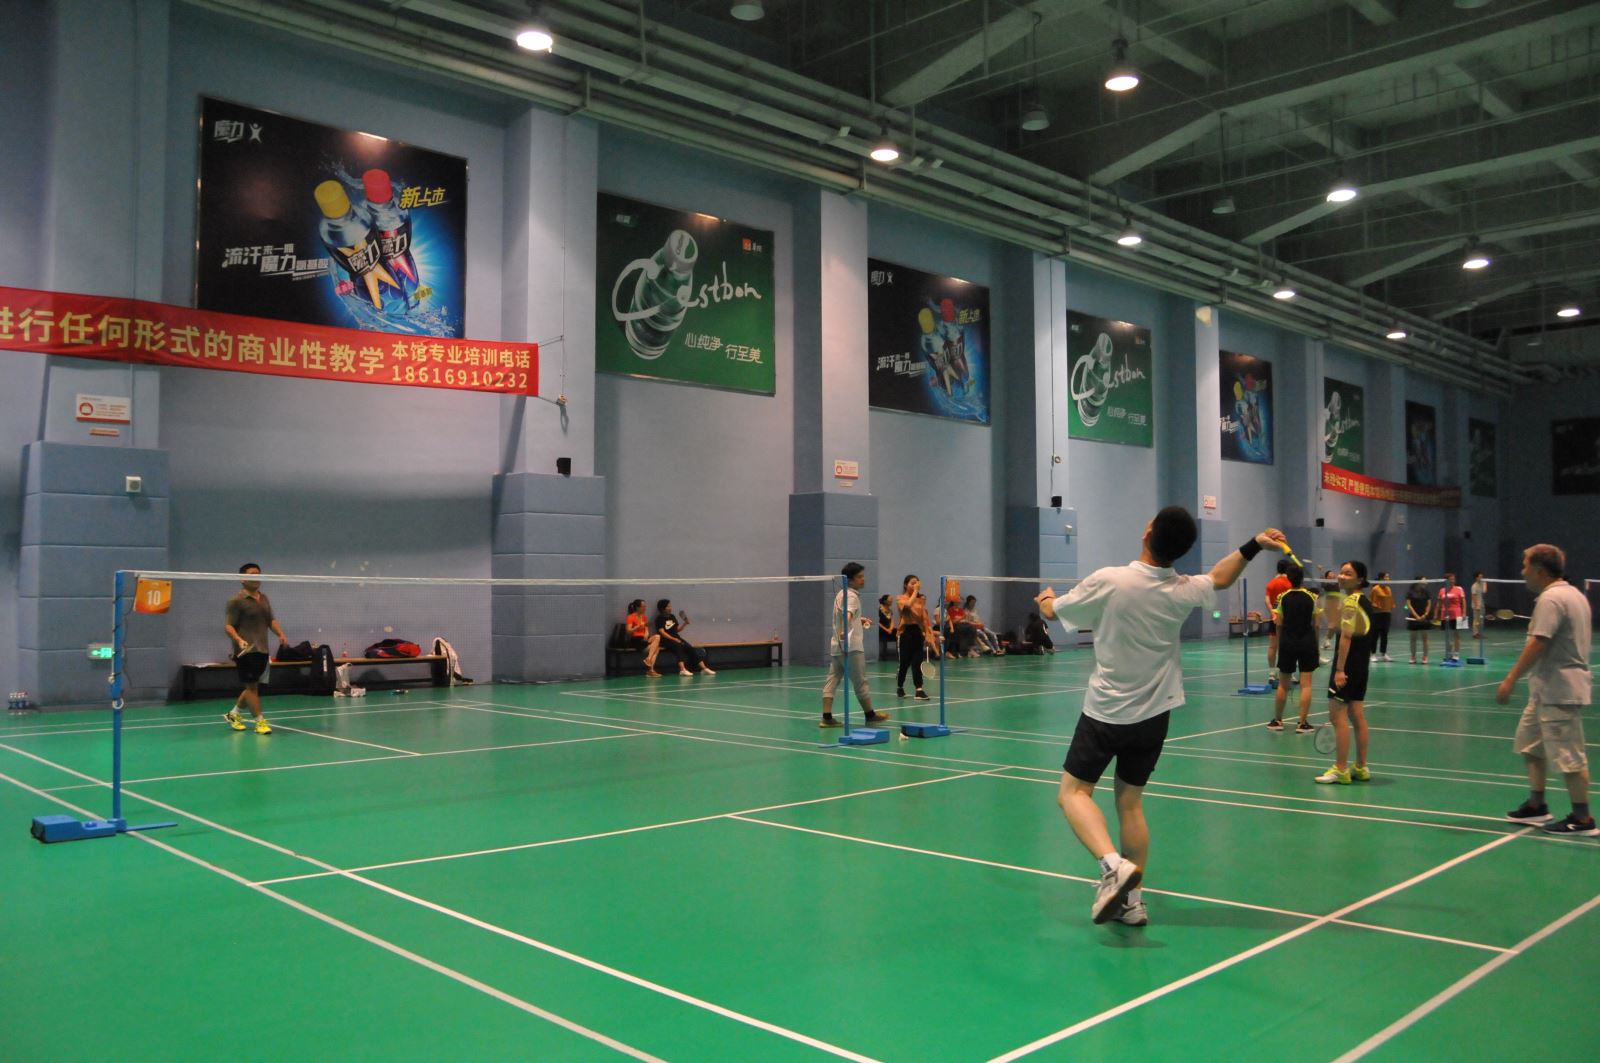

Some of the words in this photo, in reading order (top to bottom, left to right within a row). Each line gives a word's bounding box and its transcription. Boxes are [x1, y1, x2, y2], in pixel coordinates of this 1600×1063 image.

[214, 120, 244, 142] 魔力
[400, 186, 446, 209] 新上市
[0, 306, 385, 375] 进行任何形式的商业性教学
[391, 340, 531, 369] 本馆专业培训电话
[725, 343, 763, 364] 行至美
[391, 364, 528, 389] 18616910232
[148, 590, 160, 606] 10
